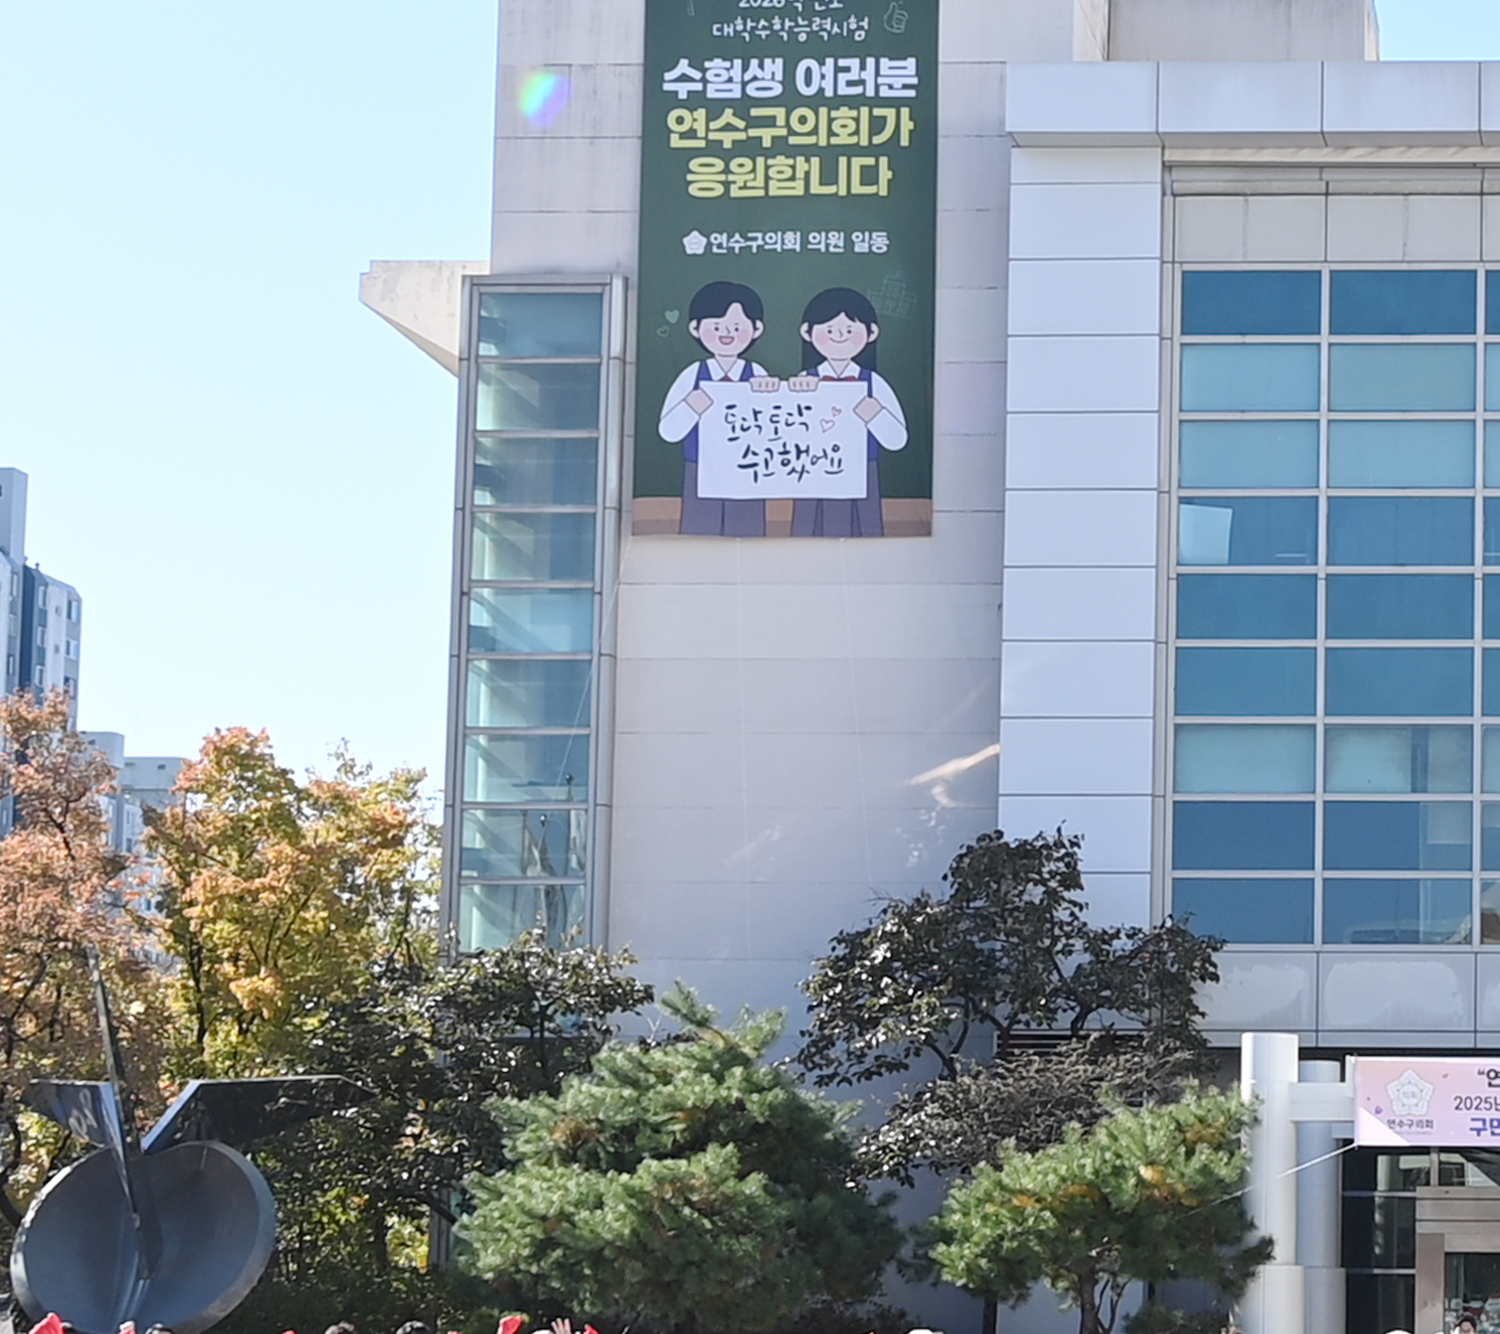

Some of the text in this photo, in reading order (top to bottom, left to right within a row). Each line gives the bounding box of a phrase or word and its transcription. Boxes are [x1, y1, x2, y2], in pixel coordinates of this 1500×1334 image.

[711, 15, 870, 43] 대학수학능력시험
[661, 56, 920, 100] 수험생 여러분
[665, 106, 916, 150] 연수구의회가
[685, 155, 894, 199] 응원합니다
[709, 230, 802, 255] 연수구의회
[806, 230, 846, 254] 의원
[851, 230, 891, 255] 일동
[735, 443, 846, 485] 수고했어요
